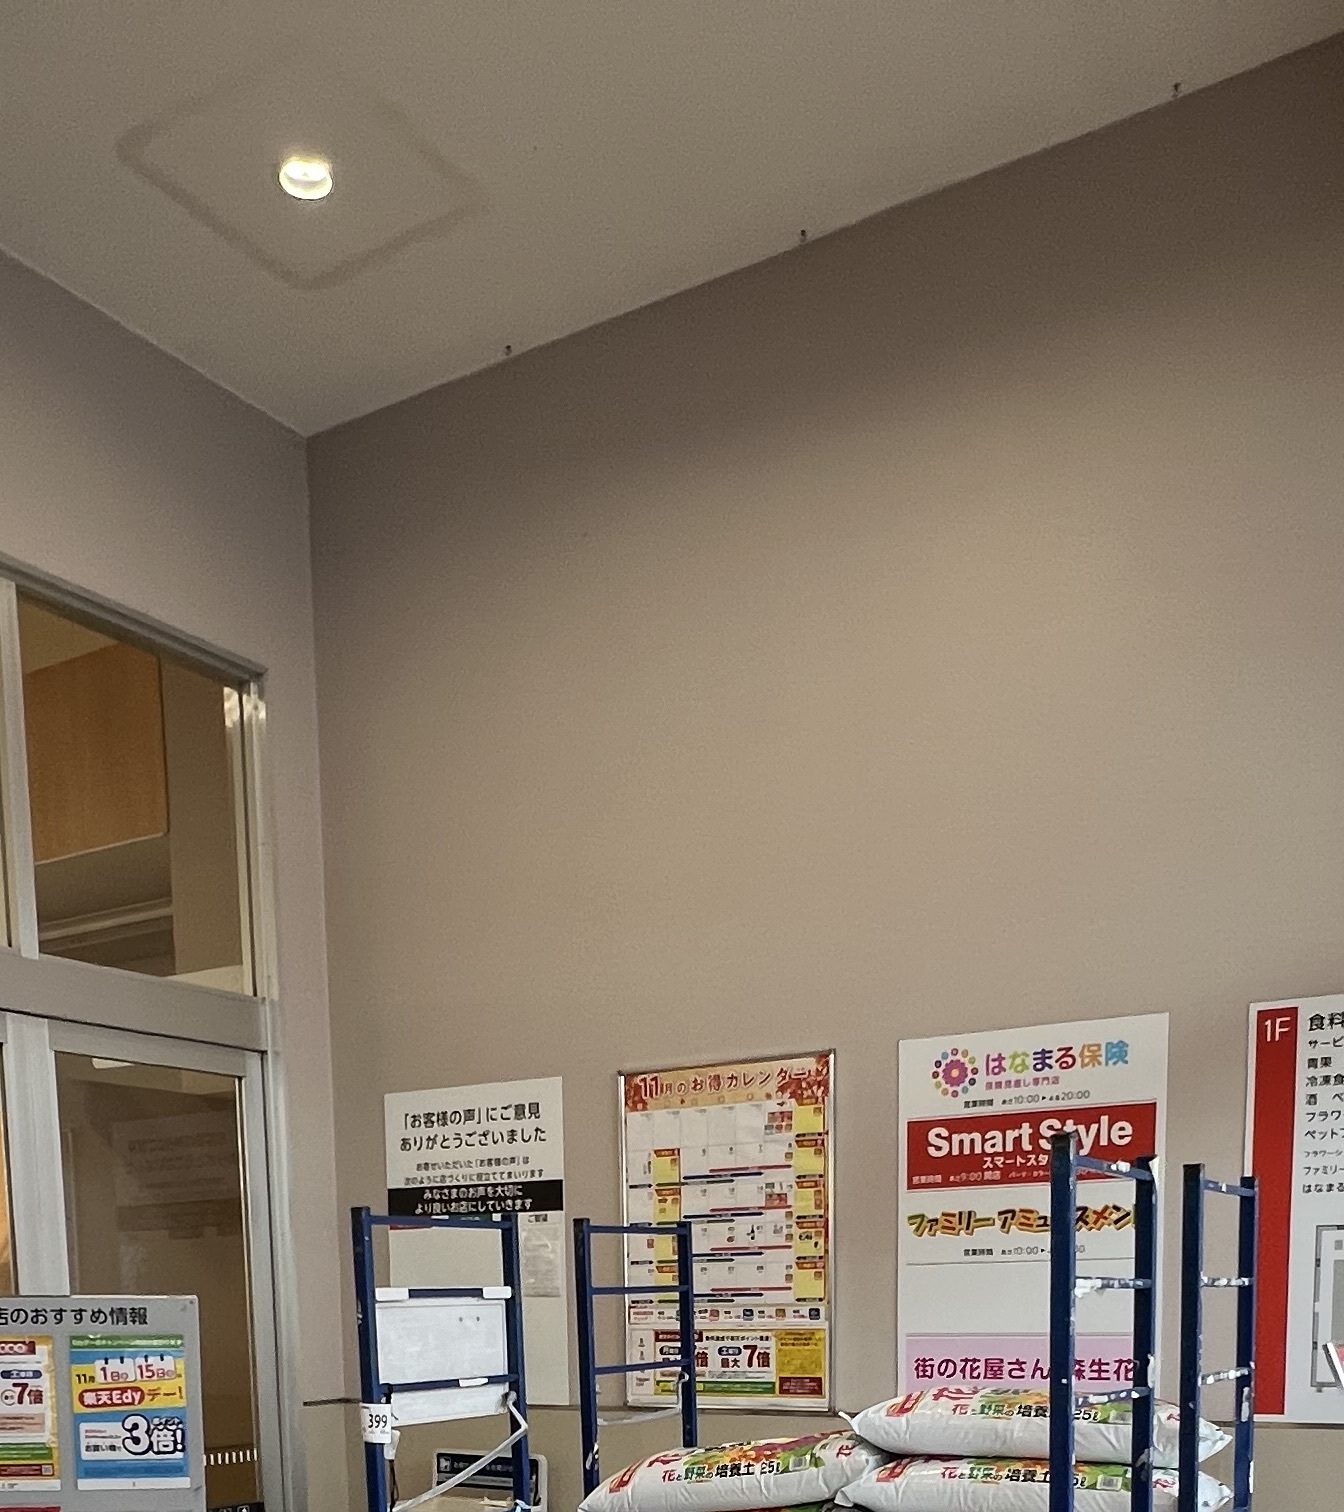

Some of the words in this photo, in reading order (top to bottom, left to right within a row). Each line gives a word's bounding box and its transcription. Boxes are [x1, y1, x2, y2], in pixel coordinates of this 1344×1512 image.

[1264, 1016, 1292, 1042] 1F
[985, 1039, 1130, 1077] はなまる保険
[403, 1101, 541, 1131] 「お客様の声」にご意見
[399, 1126, 547, 1152] ありがとうございました
[927, 1121, 1033, 1158] Smart
[913, 1357, 1051, 1381] 街の花屋さん
[82, 1389, 142, 1406] 楽天Edy
[367, 1413, 388, 1429] 399
[951, 1403, 1051, 1419] 花と野菜の培養
